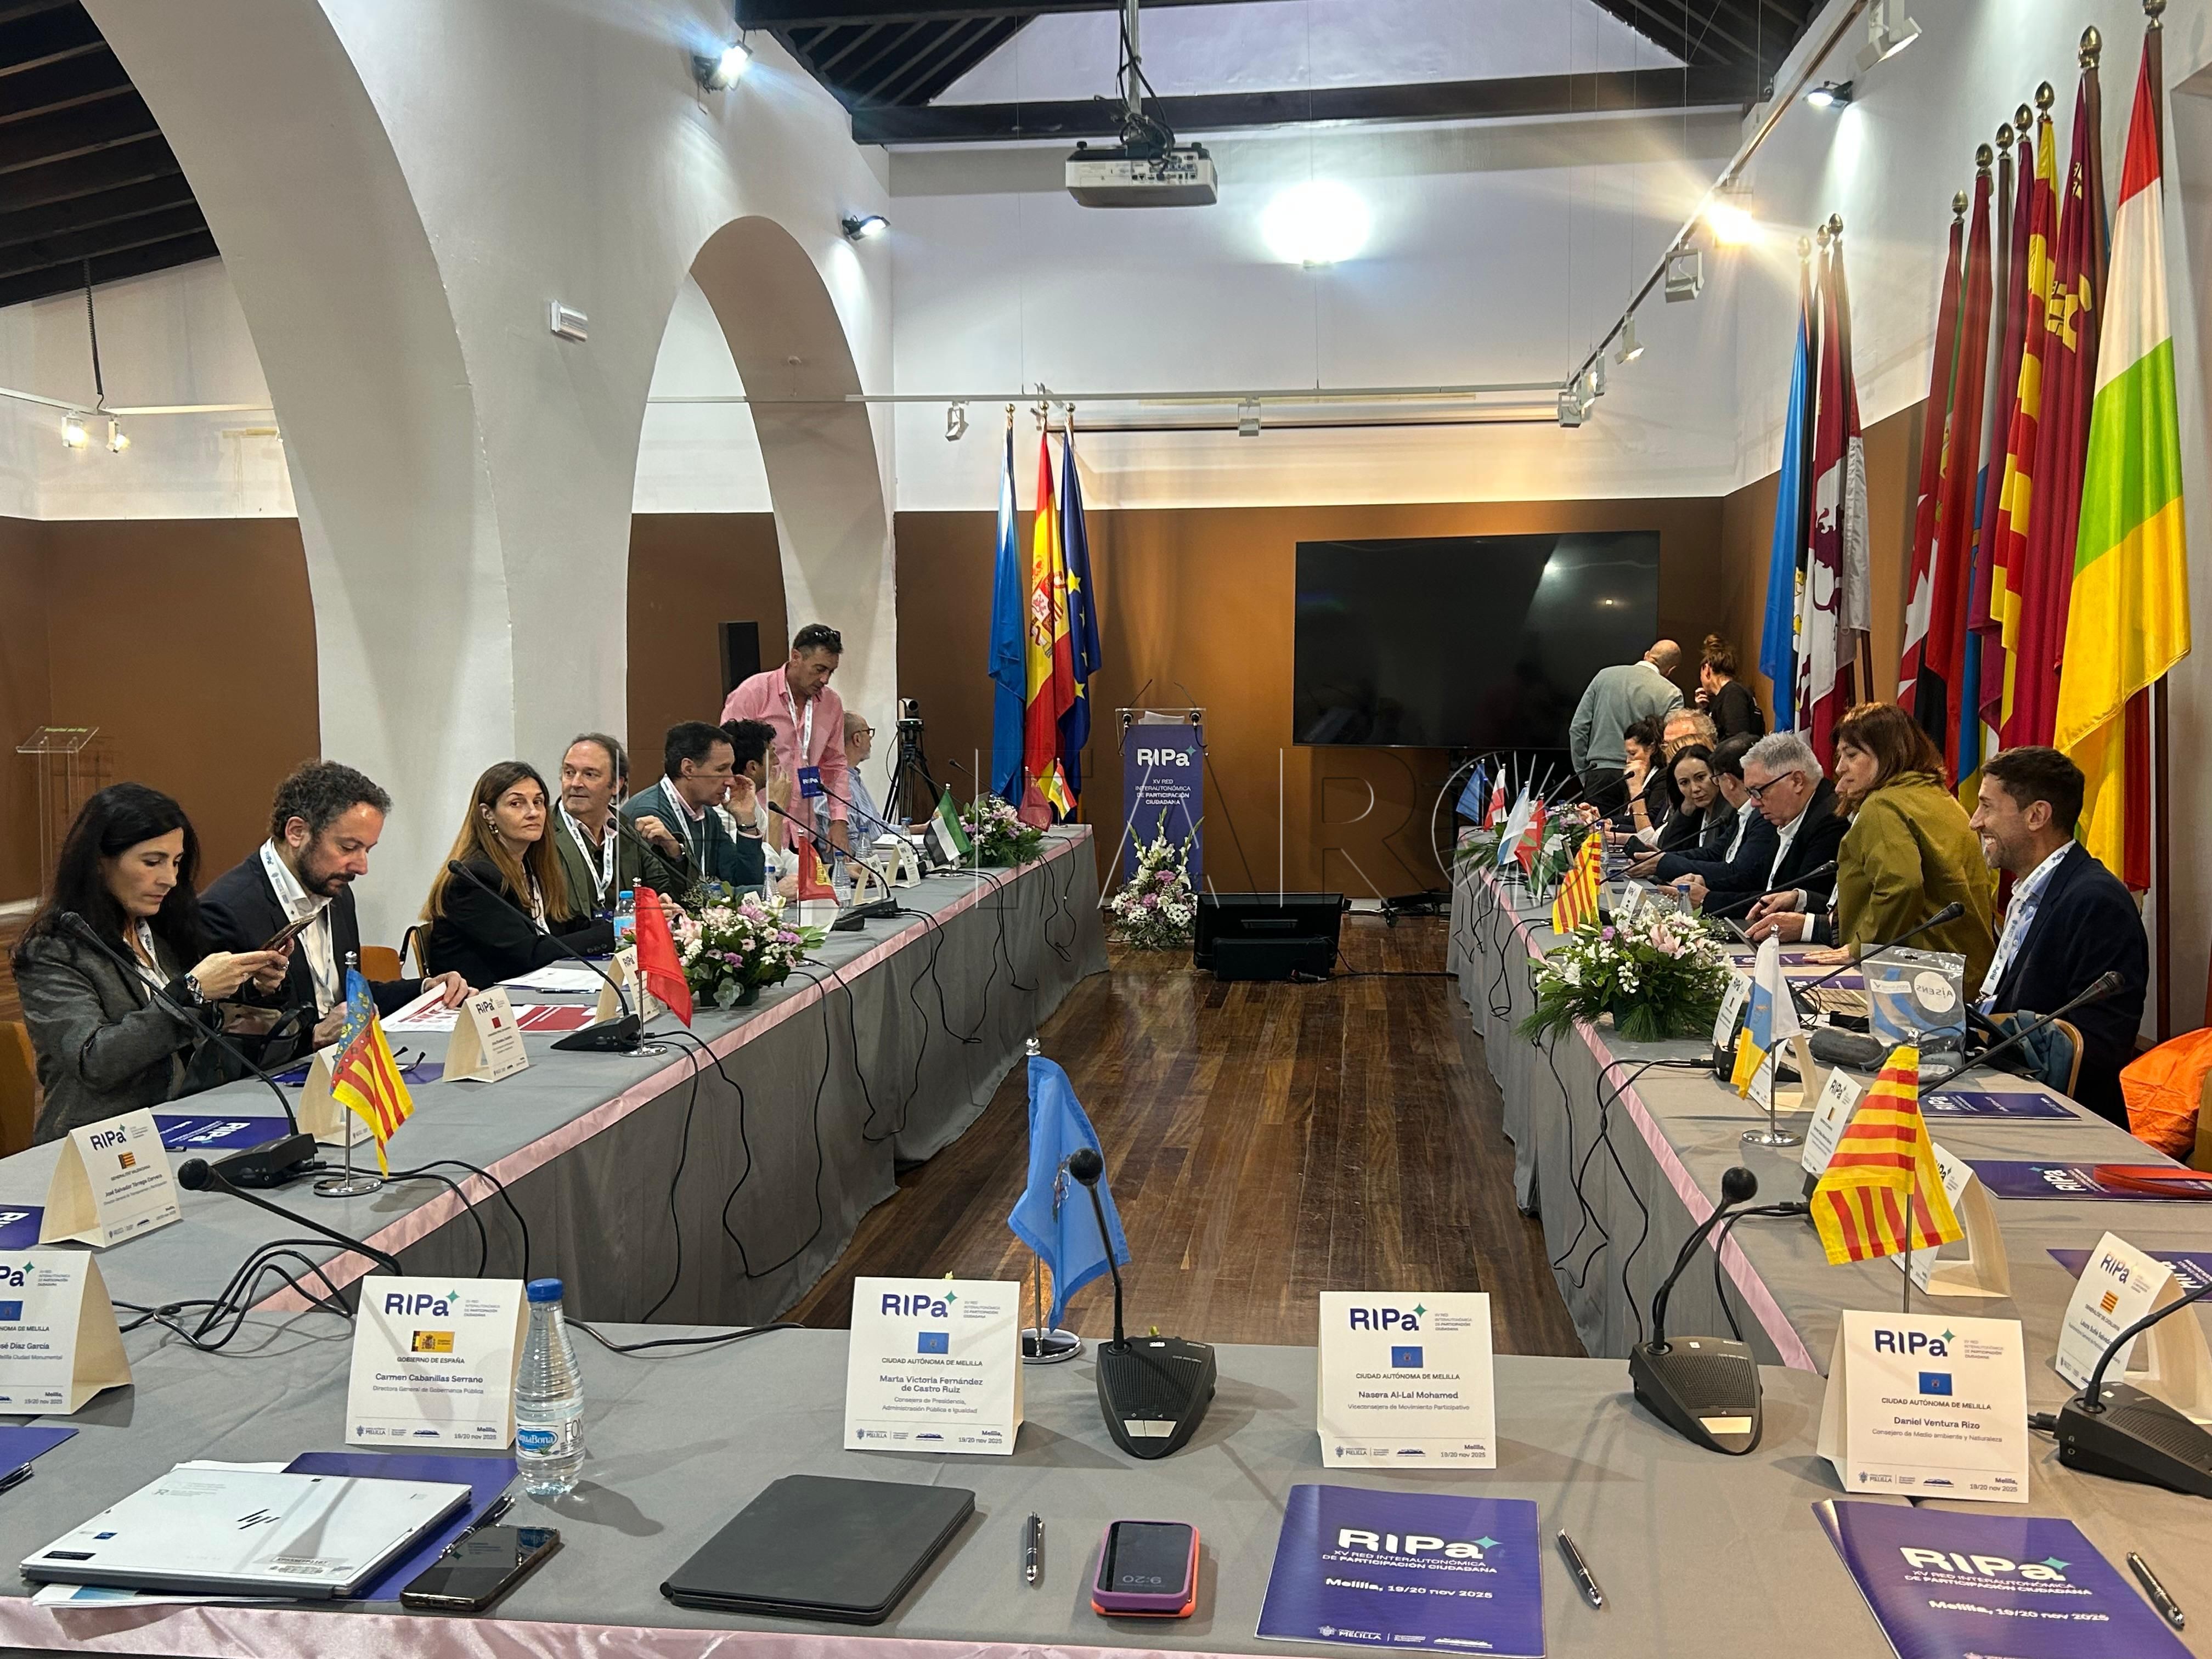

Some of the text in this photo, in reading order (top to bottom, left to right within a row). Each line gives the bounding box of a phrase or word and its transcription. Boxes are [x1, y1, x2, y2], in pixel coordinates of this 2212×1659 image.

[1137, 748, 1189, 766] RIPa
[476, 1001, 495, 1014] RIPa
[90, 1131, 126, 1150] RIPa
[188, 1123, 250, 1142] RIPa
[2044, 1170, 2086, 1191] RIPa
[2100, 1252, 2129, 1284] RIPa
[384, 1293, 449, 1317] RIPa
[882, 1294, 948, 1317] RIPa
[1350, 1308, 1419, 1330] RIPa
[1875, 1330, 1948, 1357] RIPa
[906, 1376, 938, 1384] Victoria
[940, 1376, 983, 1385] Fernández
[1910, 1398, 1949, 1407] AUTÓNOMA
[1894, 1417, 1921, 1425] Daniel
[1924, 1419, 1959, 1428] Ventura
[1338, 1528, 1483, 1560] RIPa
[1340, 1556, 1426, 1568] PARTICIPACIÓN
[1428, 1565, 1497, 1573] CIUDADANA
[1376, 1555, 1486, 1567] INTERAUTONÓMICA
[1899, 1547, 2066, 1582] RIPa
[1122, 1575, 1162, 1584] 9:20
[1326, 1578, 1383, 1592] Melilla,
[1388, 1585, 1426, 1594] 19/20
[1923, 1577, 2016, 1591] PARTICIPACIÓN
[2018, 1587, 2093, 1595] CIUDADANA
[1958, 1576, 2075, 1589] INTERAUTONÓMICA
[1929, 1600, 1993, 1615] Melilla,
[1995, 1609, 2038, 1617] 19/20
